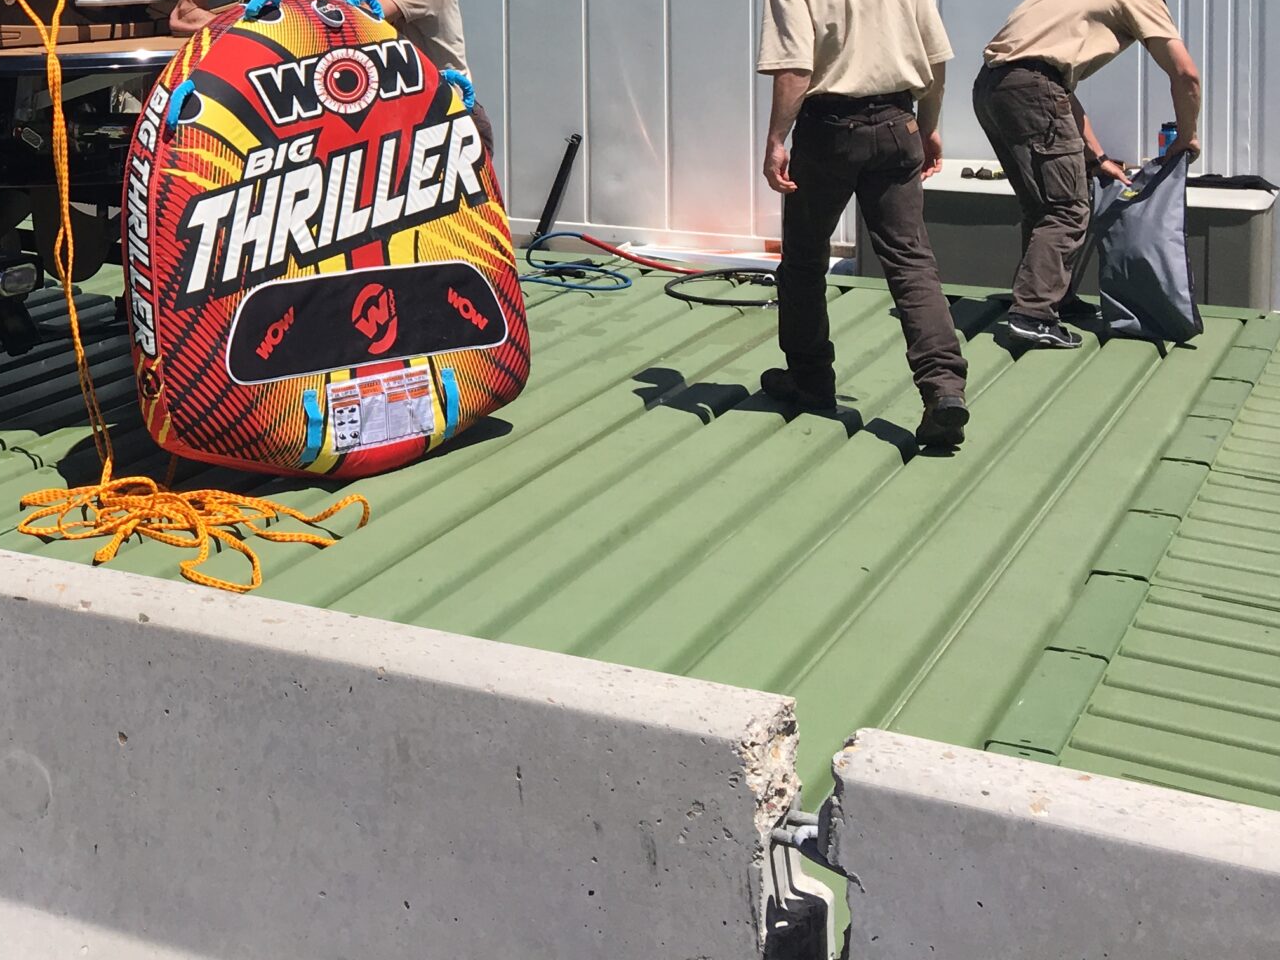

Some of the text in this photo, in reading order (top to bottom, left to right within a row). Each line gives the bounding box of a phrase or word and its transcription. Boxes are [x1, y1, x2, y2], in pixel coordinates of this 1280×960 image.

[247, 39, 425, 125] WOW
[244, 133, 315, 179] BIG
[127, 83, 170, 357] BIG THRILLER
[185, 115, 483, 294] THRILLER
[255, 305, 296, 361] WOW
[447, 286, 489, 331] WOW
